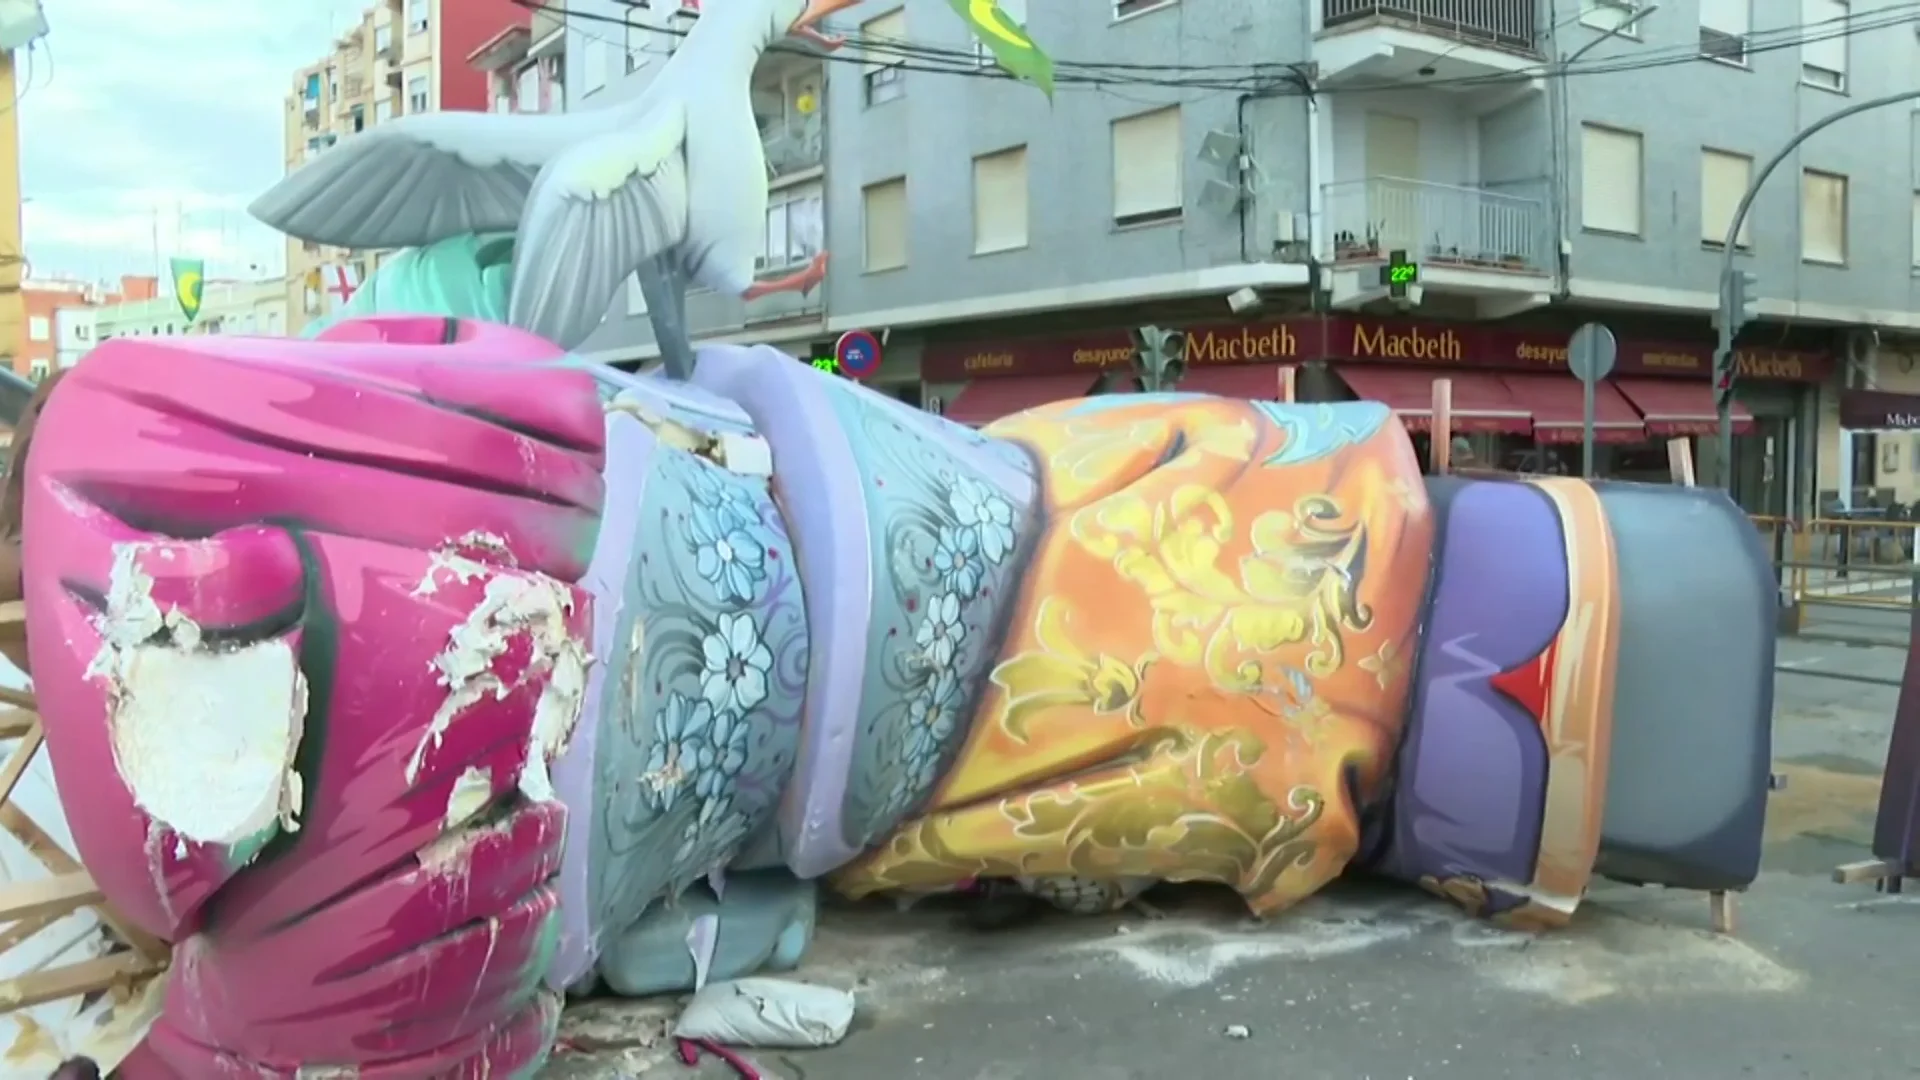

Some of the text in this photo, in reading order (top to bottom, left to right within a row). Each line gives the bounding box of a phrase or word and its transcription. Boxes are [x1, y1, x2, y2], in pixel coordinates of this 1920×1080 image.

[1184, 324, 1297, 362] Macbeth
[1353, 323, 1461, 361] Macbeth
[1735, 350, 1803, 378] Macbeth
